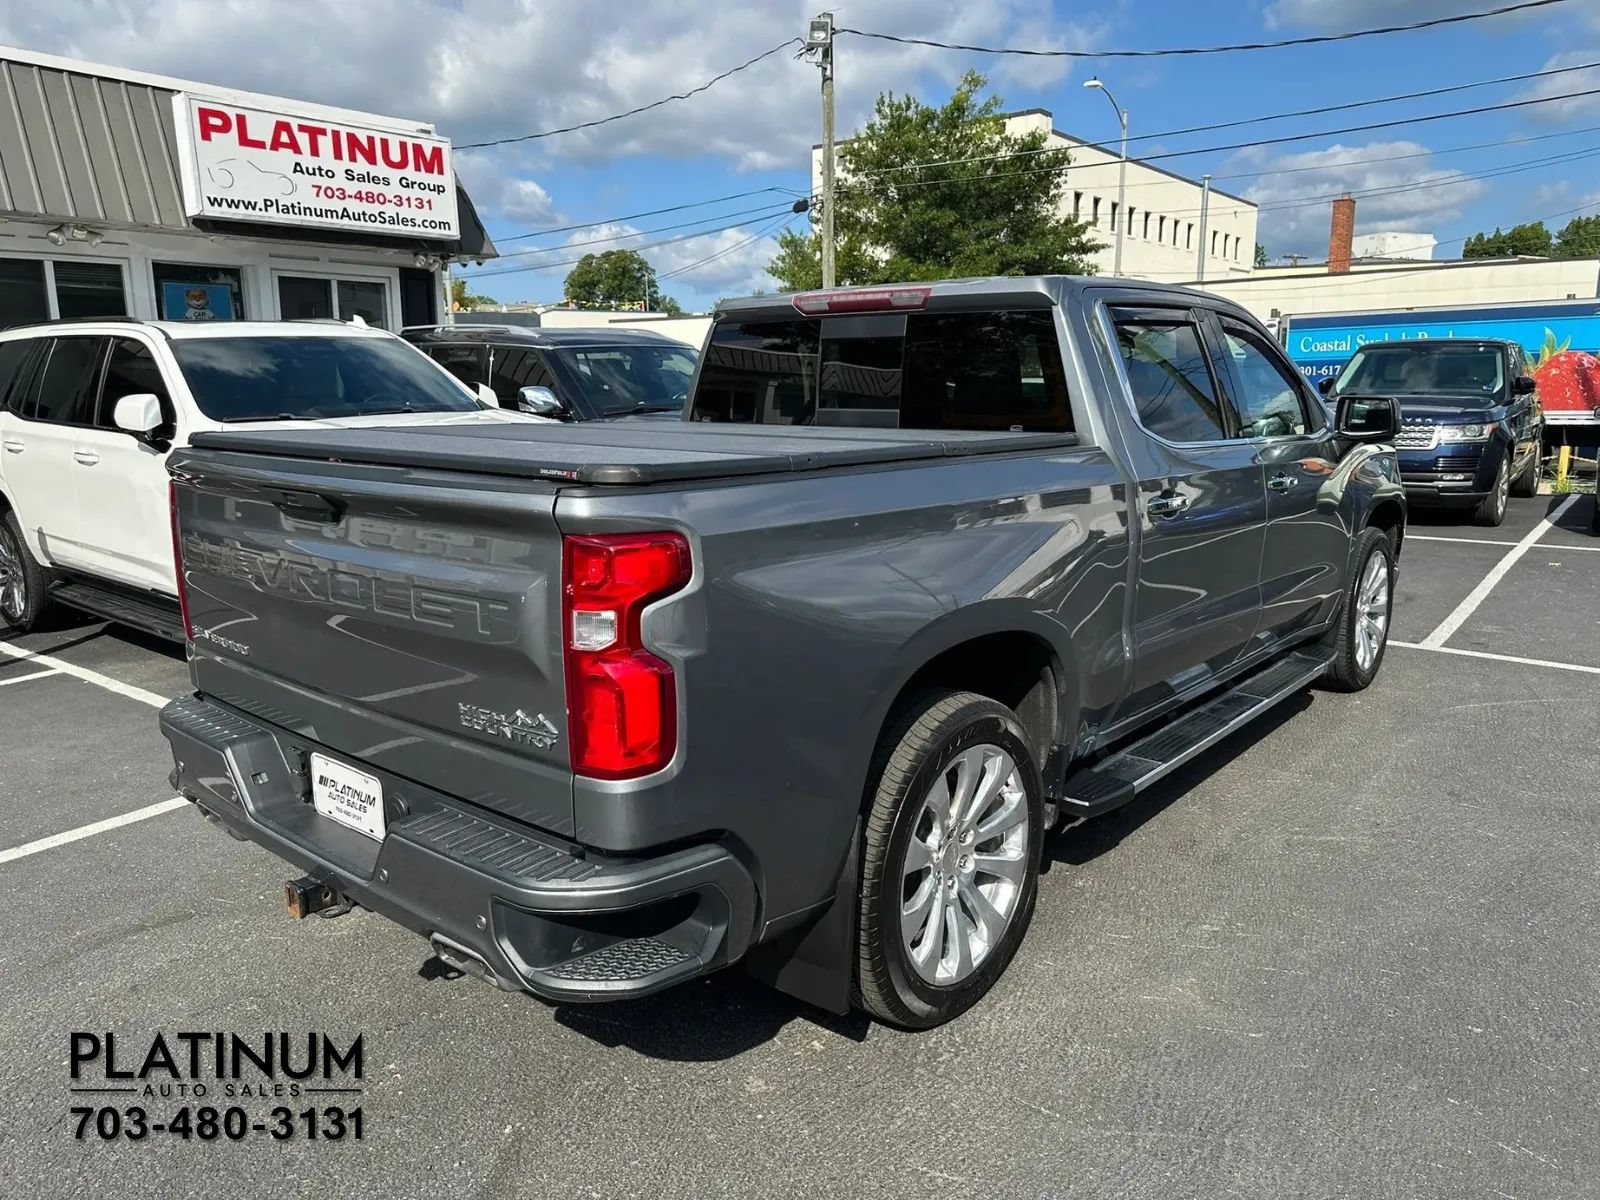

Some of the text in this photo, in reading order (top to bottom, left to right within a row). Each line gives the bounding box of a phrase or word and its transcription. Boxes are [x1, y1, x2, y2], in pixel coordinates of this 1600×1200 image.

[197, 106, 445, 176] PLATINUM
[292, 162, 446, 195] Auto Sales Group
[311, 184, 433, 211] 703-480-3131
[206, 195, 452, 231] www.PlatinumAutoSales.com
[1300, 335, 1351, 352] Coastal
[184, 533, 510, 637] CHEVROLET
[458, 702, 506, 722] HIGH
[461, 716, 558, 750] COUNTRY
[328, 792, 367, 814] AUTO SALES
[329, 780, 376, 807] PLATINUM
